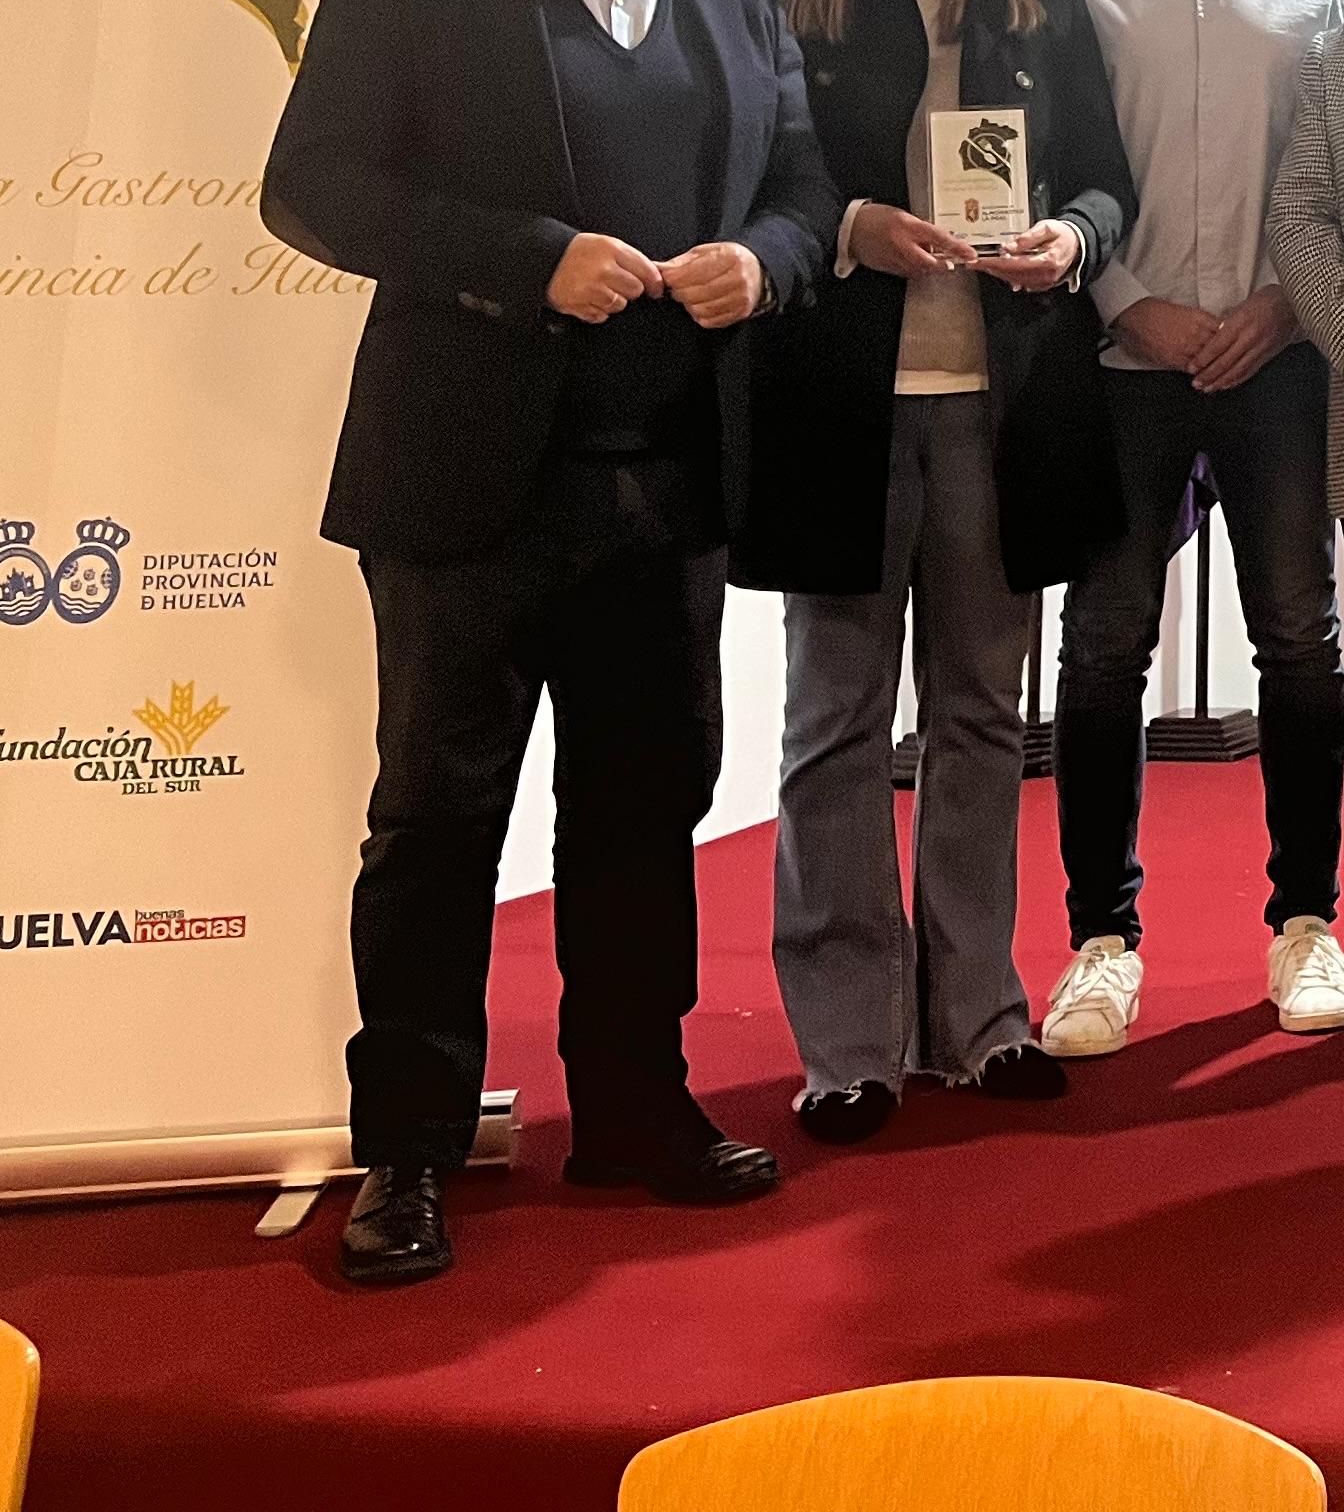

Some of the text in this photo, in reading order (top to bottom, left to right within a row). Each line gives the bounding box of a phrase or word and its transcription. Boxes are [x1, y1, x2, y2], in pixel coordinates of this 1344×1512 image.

[143, 242, 219, 296] de
[142, 547, 278, 570] DIPUTACIÓN
[141, 571, 274, 590] PROVINCIAL
[162, 592, 246, 610] HUELVA
[74, 755, 245, 782] CAJA RURAL
[121, 779, 202, 796] DEL SUR
[135, 917, 244, 943] noticias
